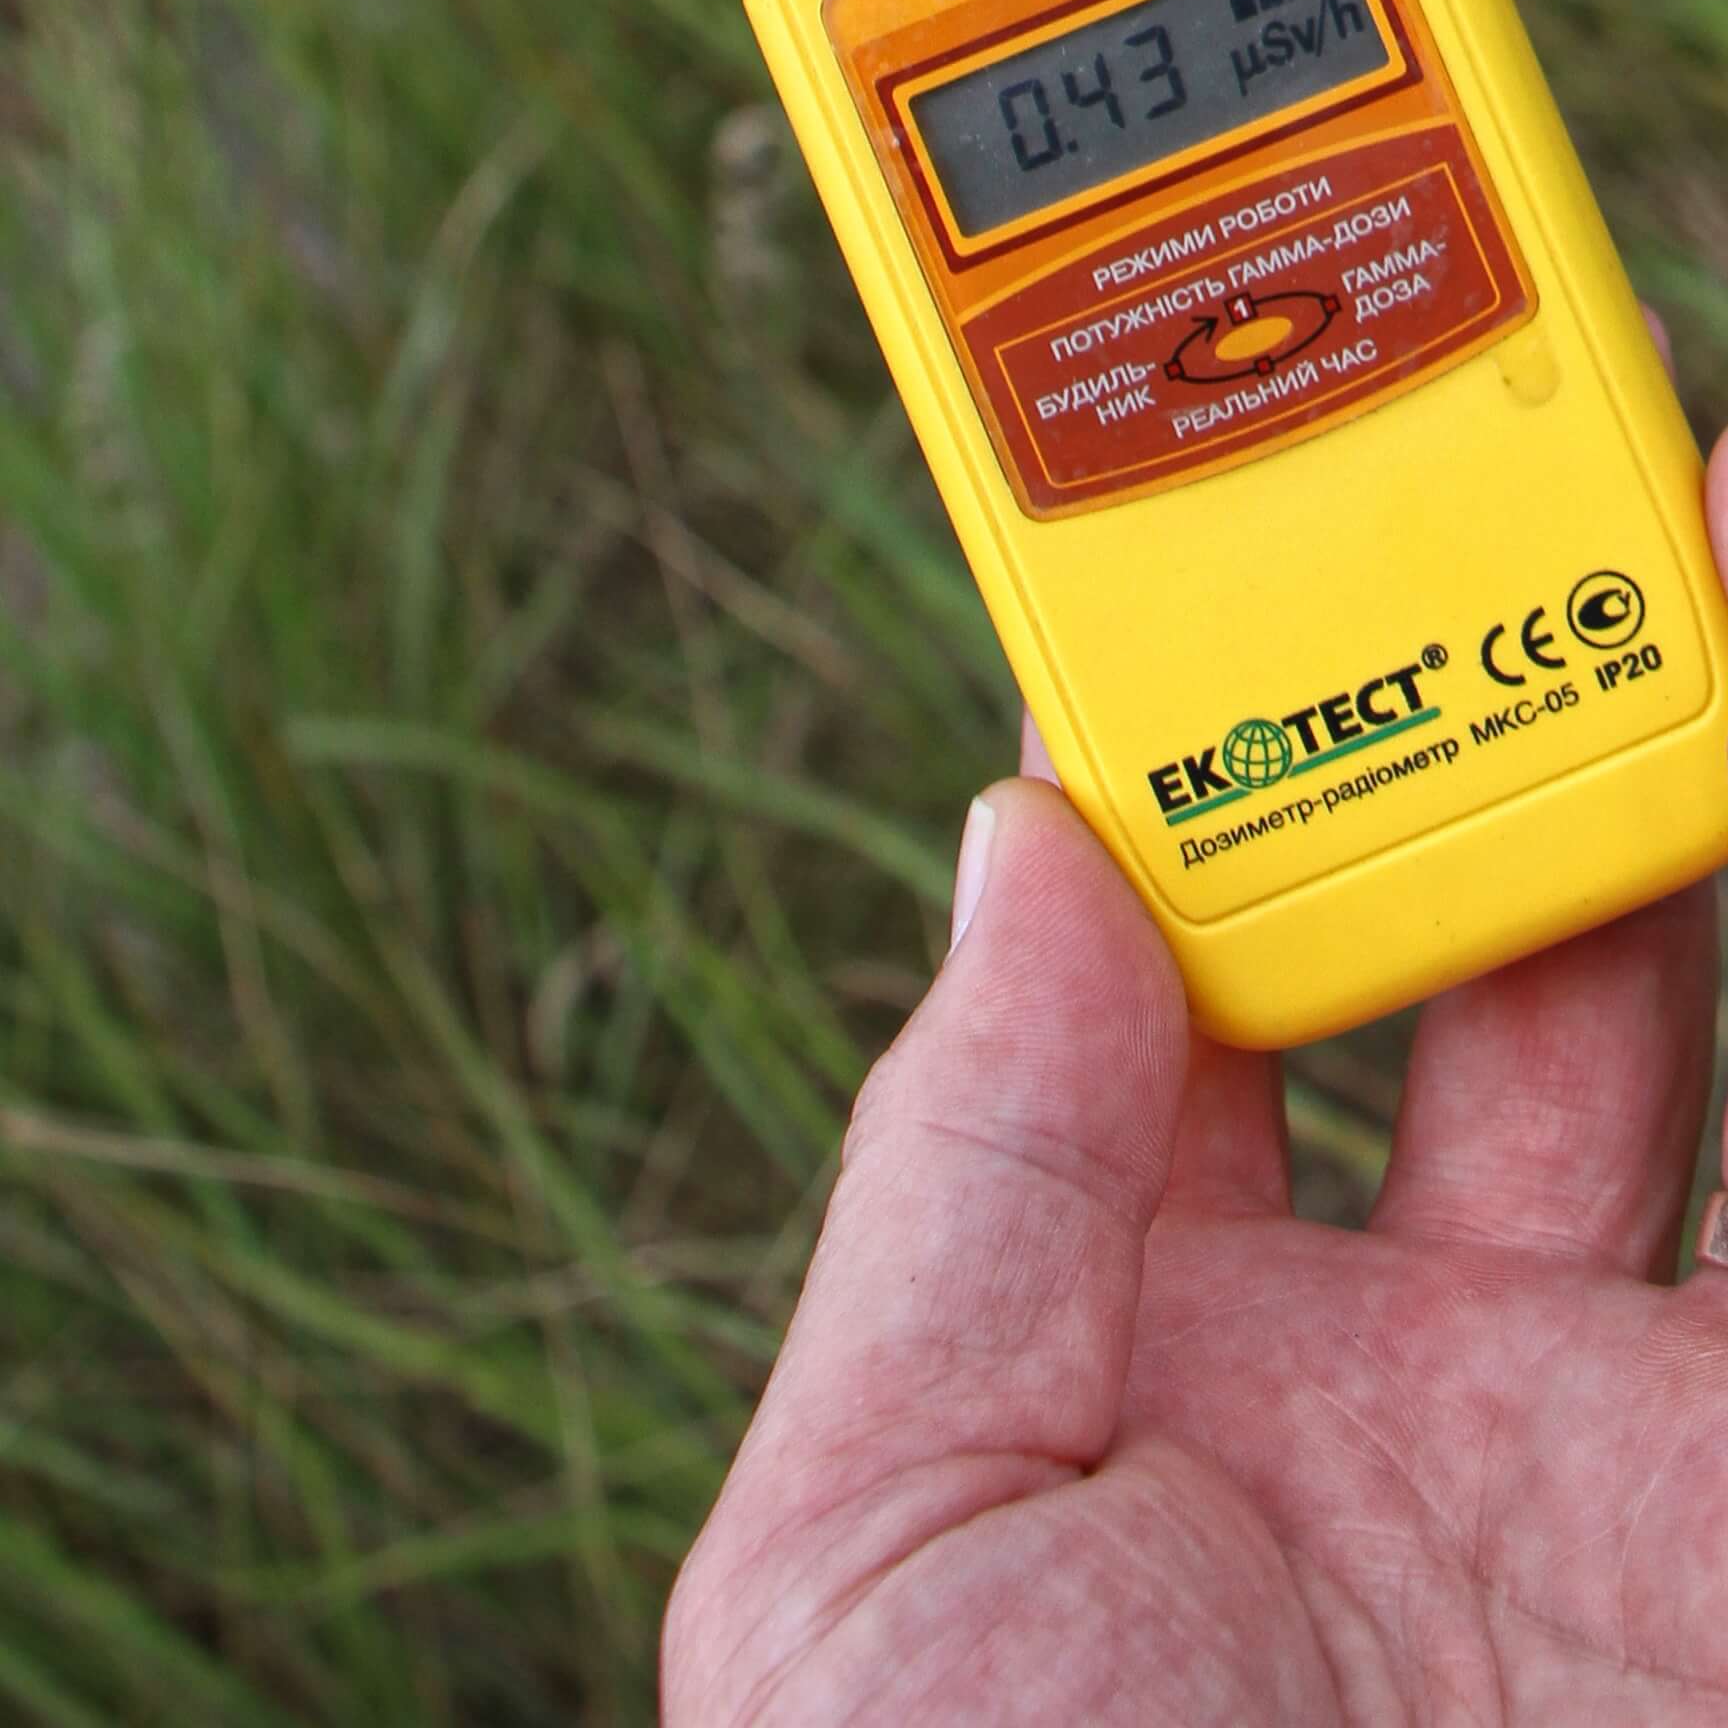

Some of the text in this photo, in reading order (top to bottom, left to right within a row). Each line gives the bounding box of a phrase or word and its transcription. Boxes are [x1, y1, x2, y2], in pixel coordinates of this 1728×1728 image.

[1000, 25, 1187, 172] 0.43
[1092, 176, 1333, 291] РЕЖИМИ РОБОТИ
[1050, 196, 1411, 362] ПОТУЖНІСТЬ ГАММА-ДОЗИ
[1341, 239, 1447, 294] ГАММА-
[1233, 299, 1249, 319] 1
[1353, 274, 1431, 323] ДОЗА
[1035, 360, 1157, 420] БУДИЛЬ-
[1095, 389, 1156, 426] НИК
[1171, 338, 1378, 440] РЕАЛЬНИЙ ЧАС
[1595, 643, 1663, 692] IP20
[1178, 682, 1580, 870] Дозиметр-радіометр МКС-05
